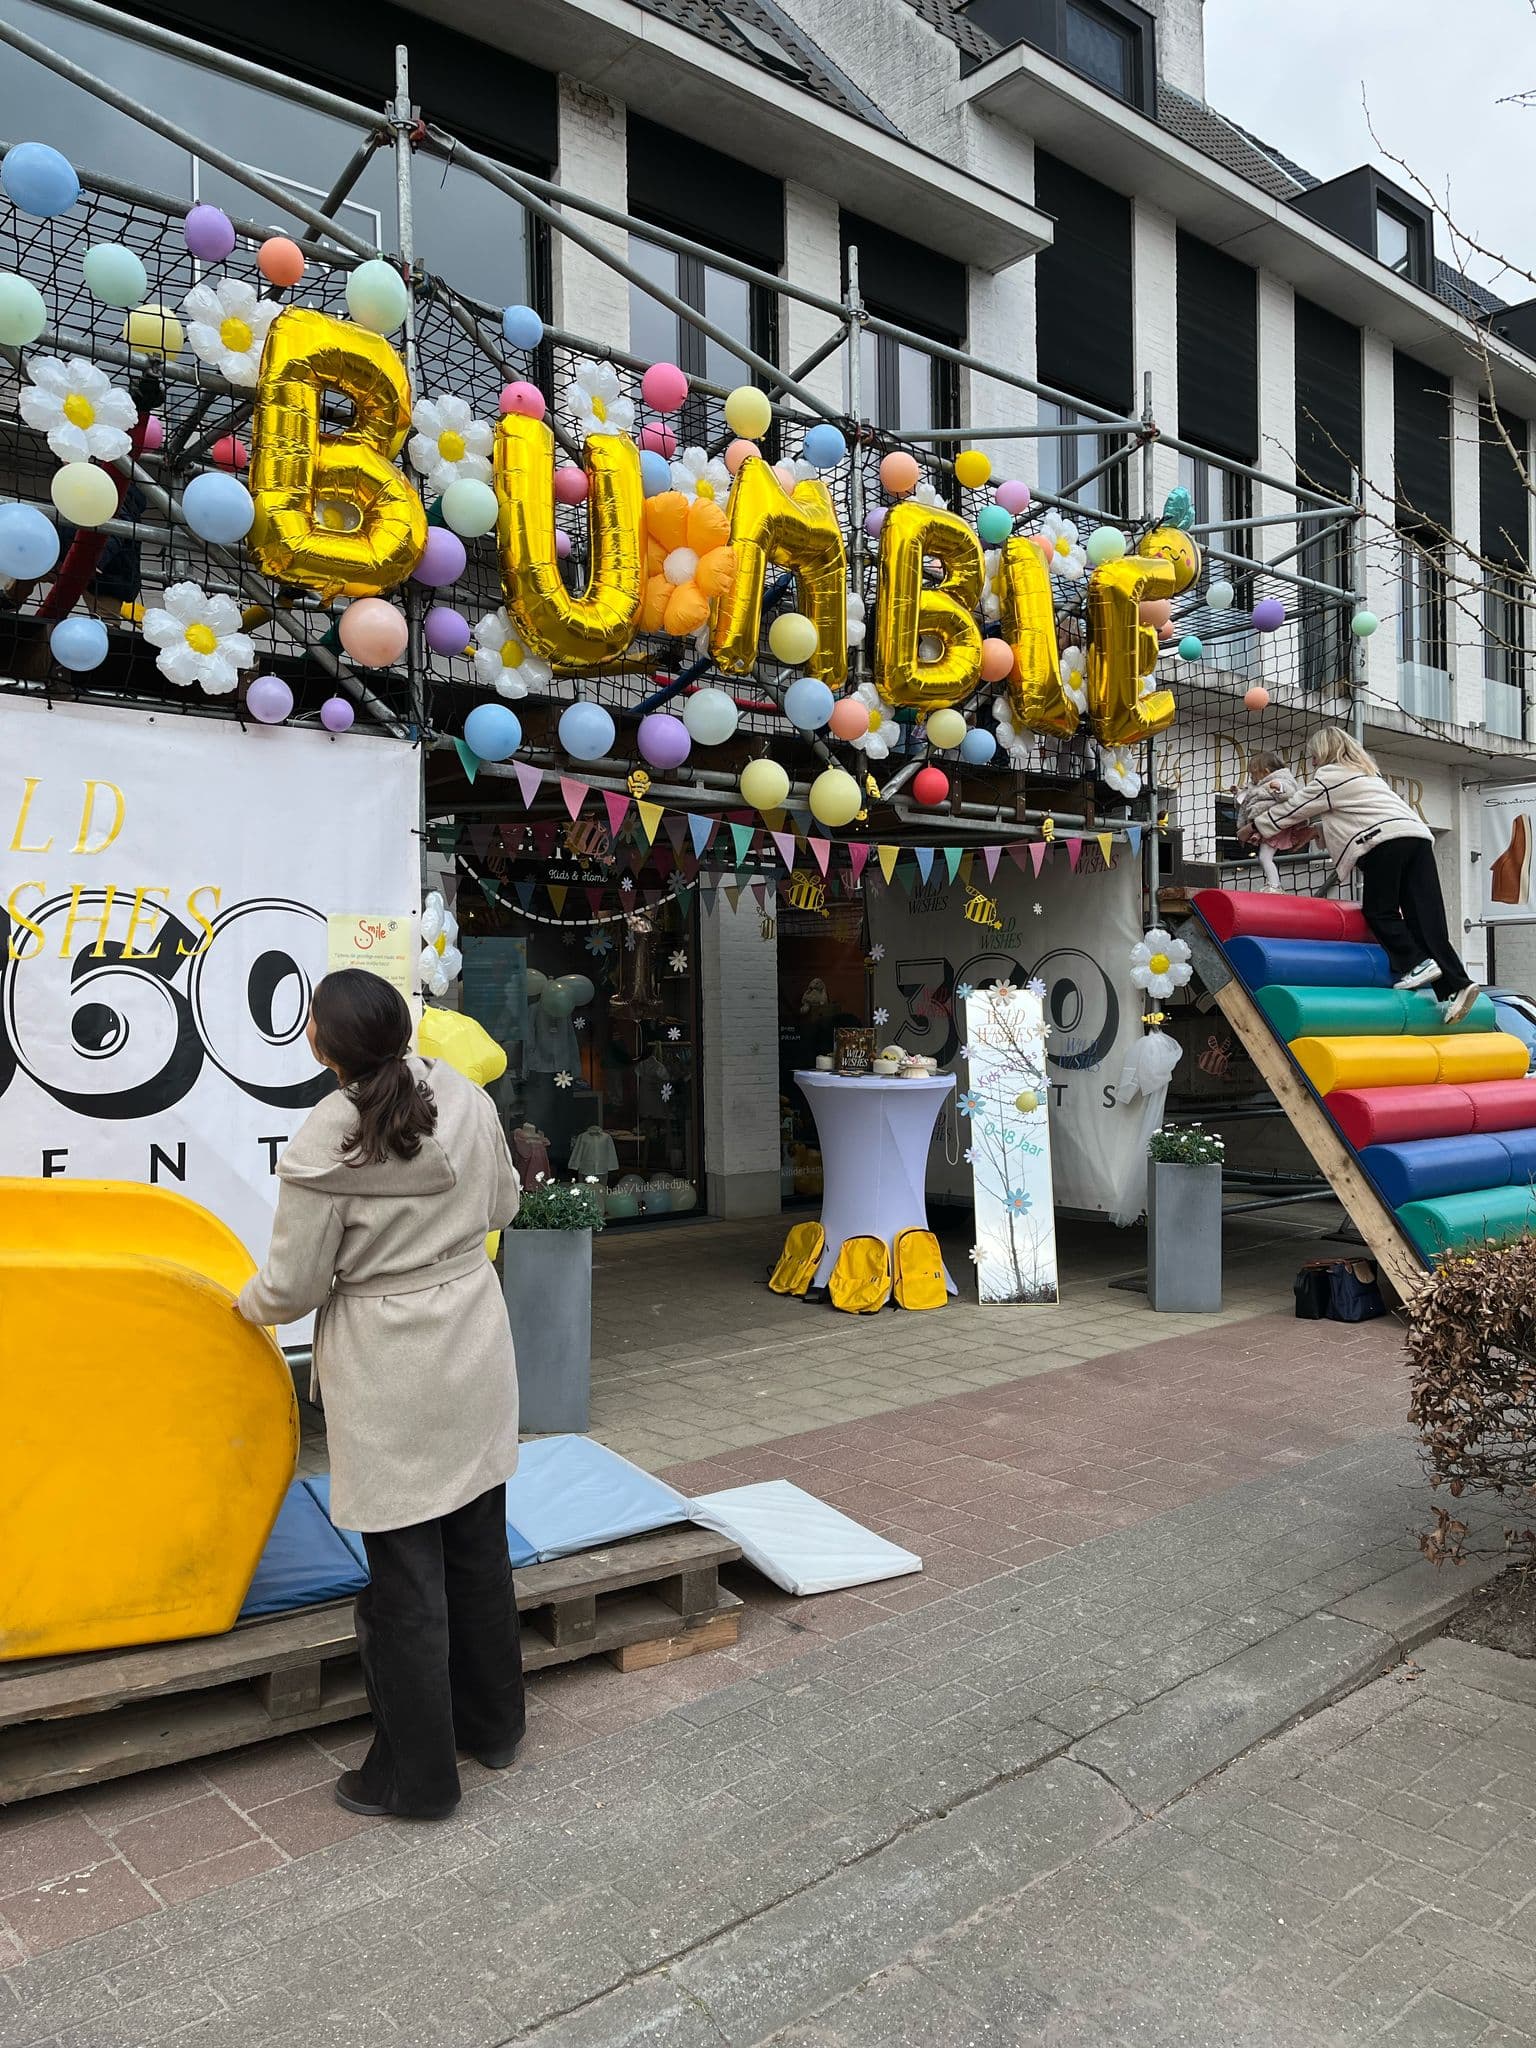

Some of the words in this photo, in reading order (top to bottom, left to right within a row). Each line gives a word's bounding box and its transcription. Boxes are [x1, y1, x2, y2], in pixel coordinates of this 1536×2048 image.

[548, 869, 569, 880] Kids
[571, 870, 578, 880] &
[908, 897, 949, 916] WISHES
[354, 920, 386, 950] Smile
[980, 932, 1023, 950] WISHES
[0, 890, 337, 1120] 60
